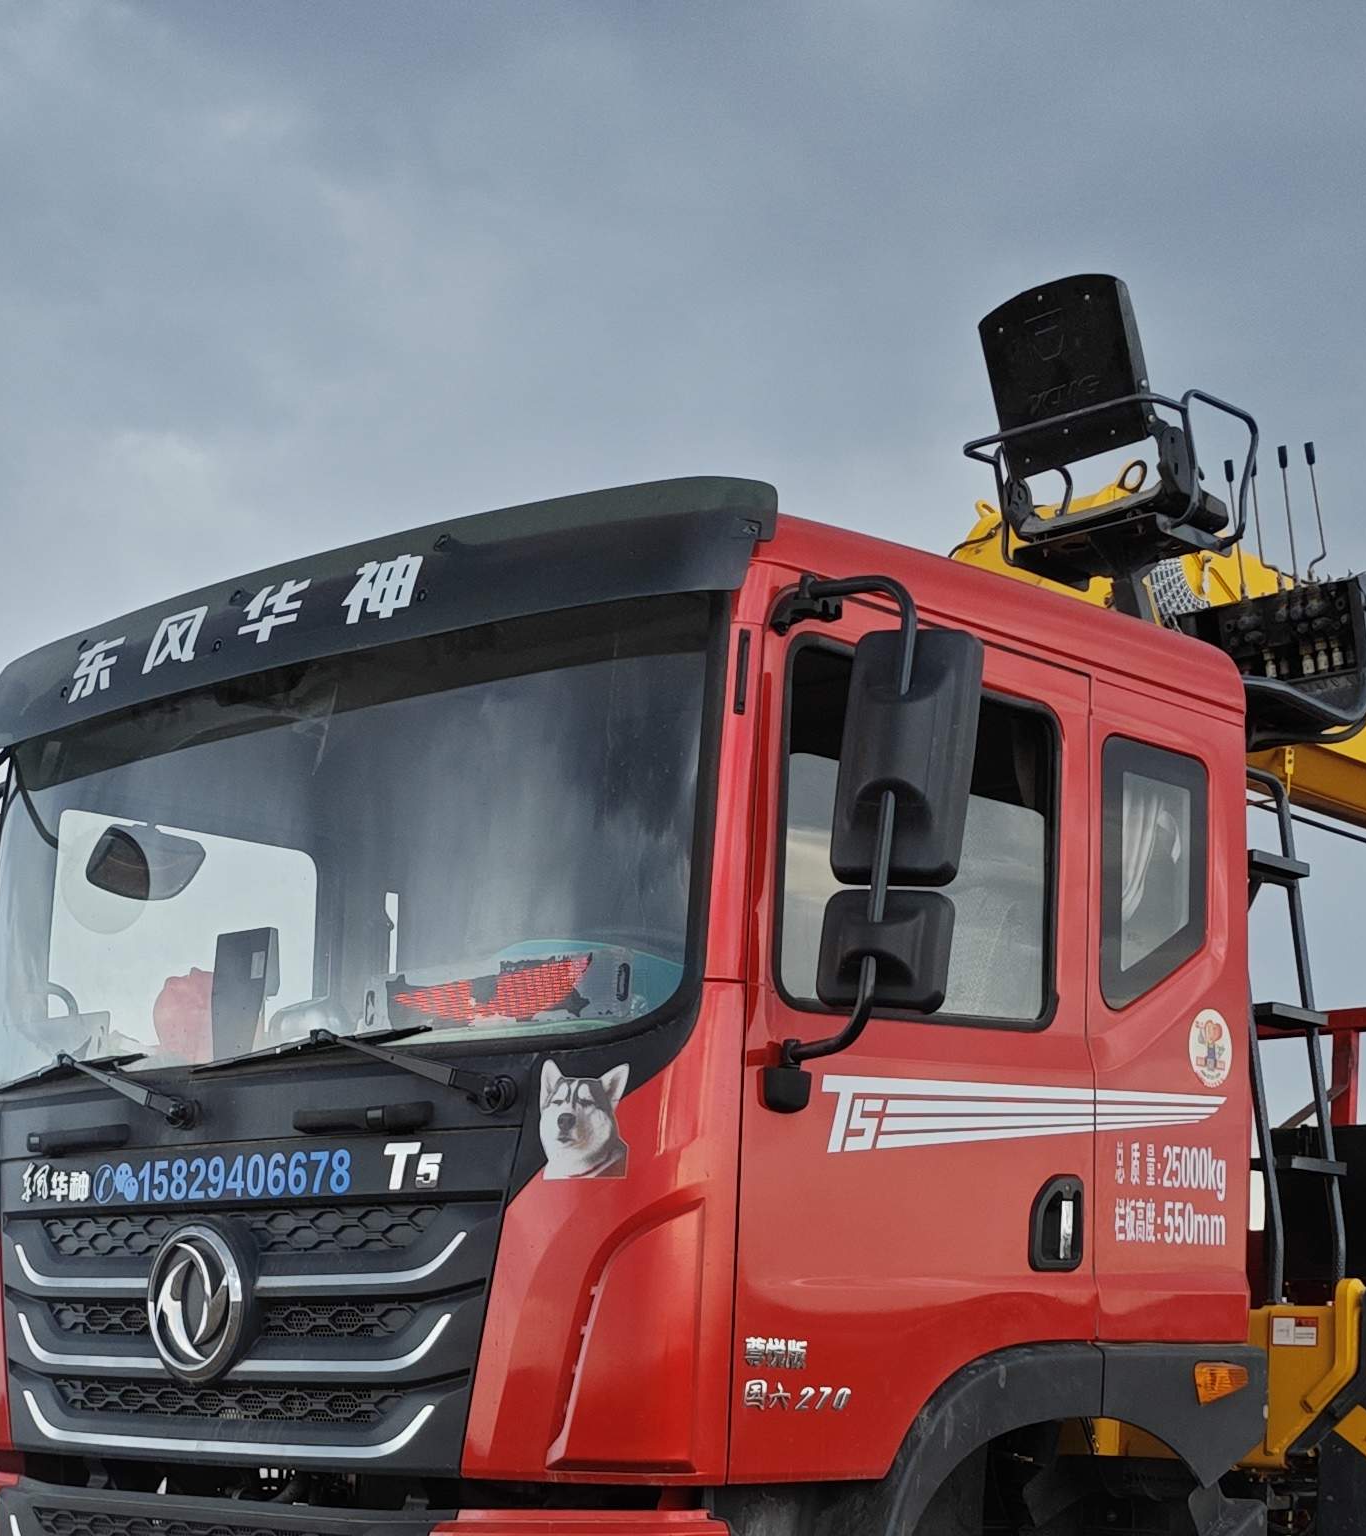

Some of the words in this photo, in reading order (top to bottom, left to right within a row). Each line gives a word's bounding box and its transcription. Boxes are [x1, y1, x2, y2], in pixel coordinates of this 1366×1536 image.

[68, 554, 424, 704] 东风华神
[139, 1148, 352, 1202] 15829406678
[383, 1141, 444, 1192] T5
